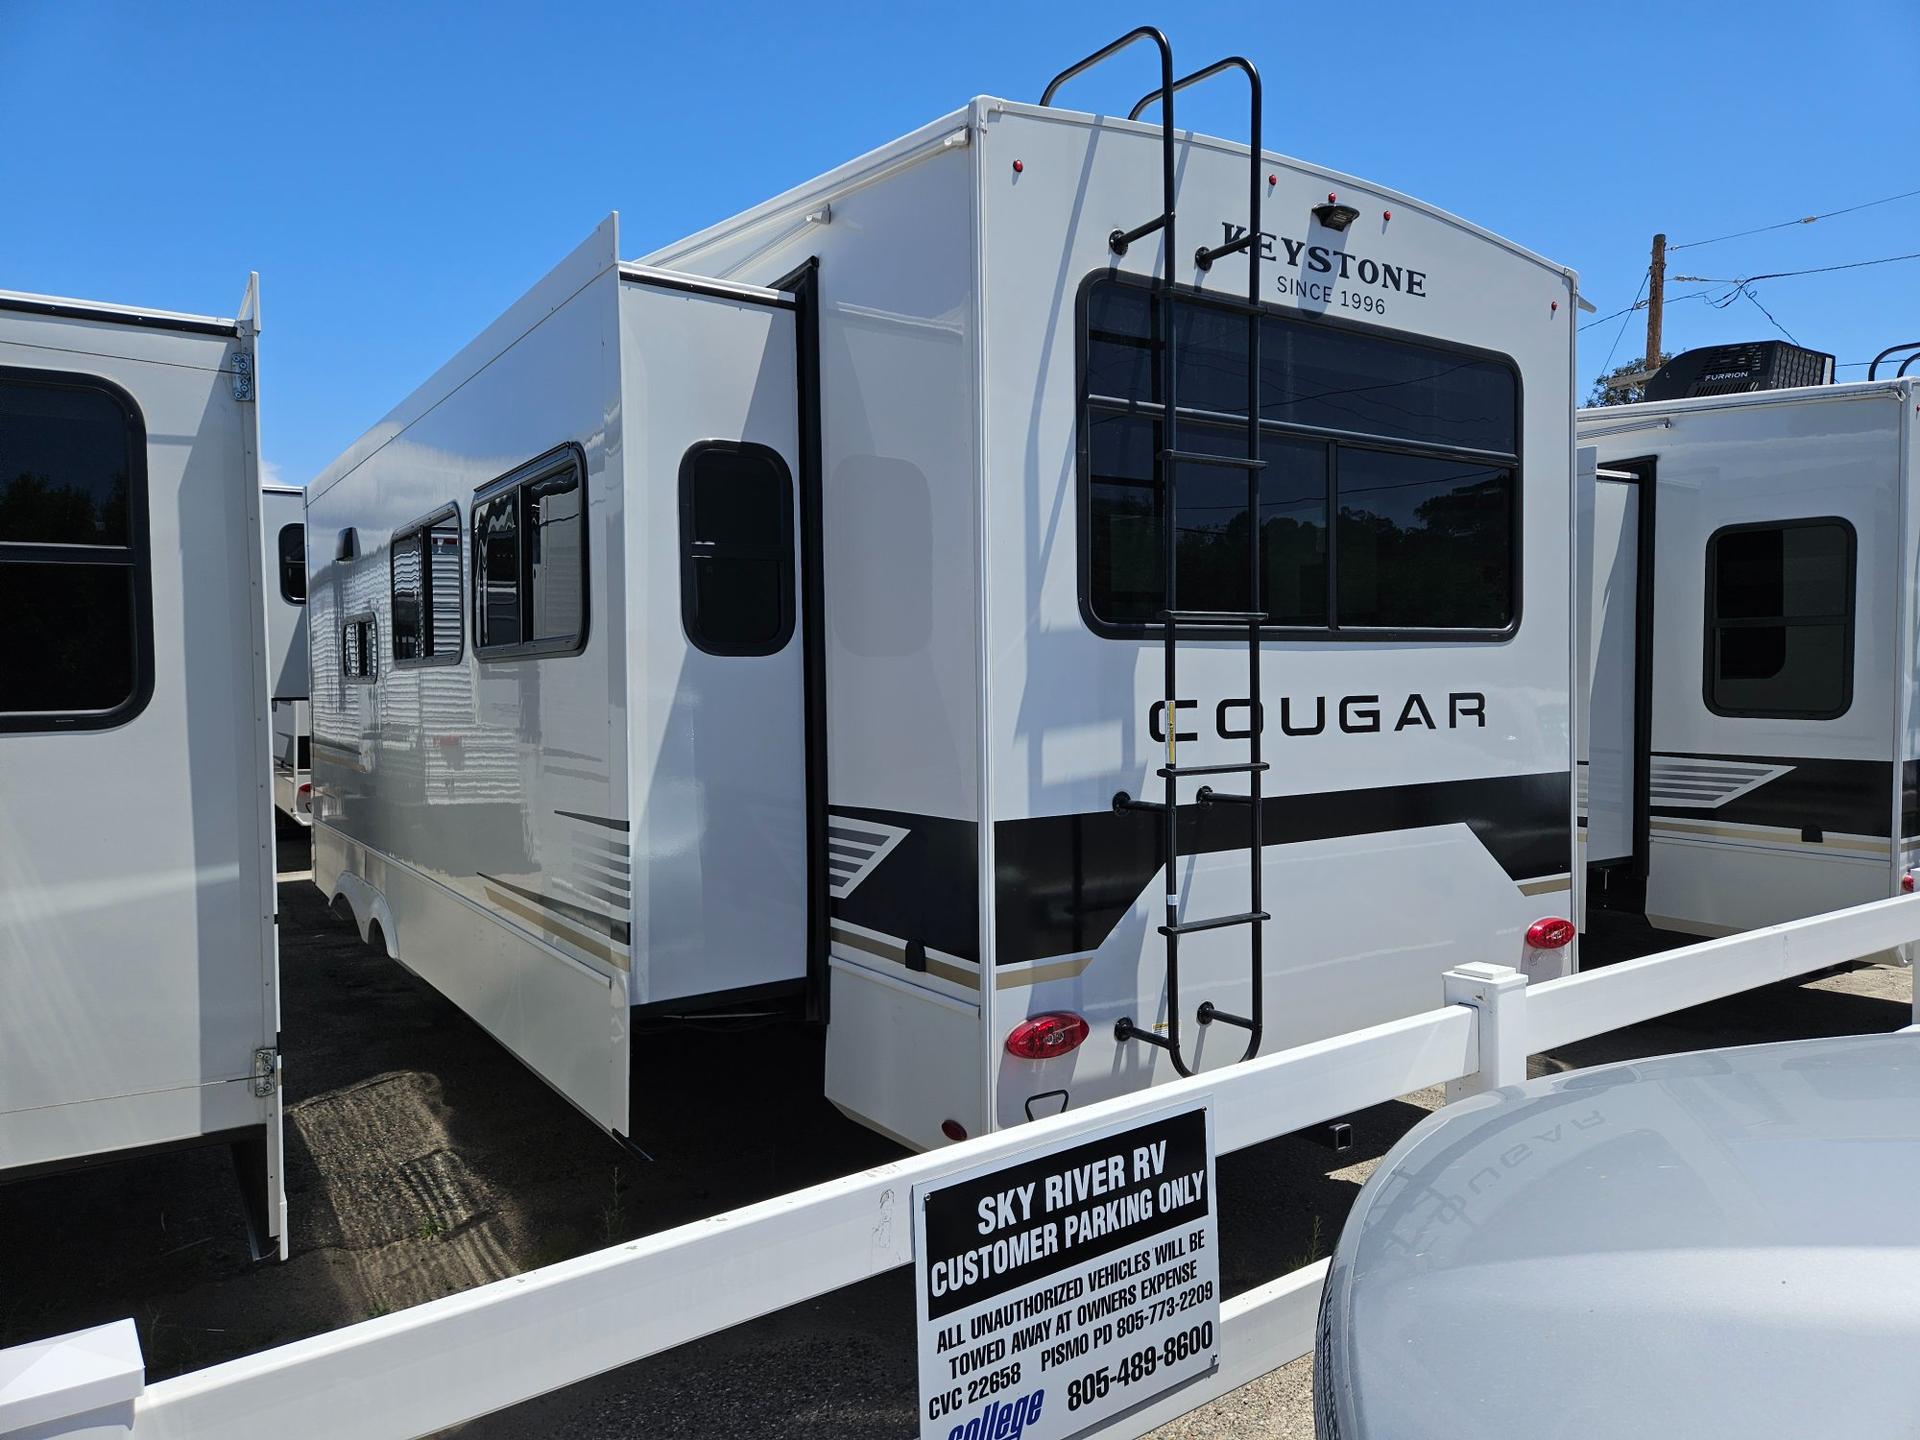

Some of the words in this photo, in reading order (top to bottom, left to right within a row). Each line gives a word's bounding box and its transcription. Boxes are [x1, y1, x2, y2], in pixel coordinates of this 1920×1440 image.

[1222, 222, 1427, 297] KEYSTONE
[1277, 275, 1332, 303] SINCE
[1341, 291, 1385, 314] 1996
[1704, 371, 1749, 381] FURRION
[1149, 692, 1486, 742] COUGAR
[931, 1223, 1058, 1297] CUSTOMER
[1065, 1189, 1152, 1248] PARKING
[1159, 1170, 1205, 1214] ONLY
[978, 1182, 1036, 1235] SKY
[1045, 1154, 1125, 1212] RIVER
[1133, 1140, 1167, 1175] RV
[937, 1327, 966, 1354] ALL
[971, 1277, 1083, 1340] UNAUTHORIZED
[1088, 1251, 1150, 1293] VEHICLES
[1154, 1238, 1186, 1266] WILL
[1189, 1229, 1205, 1250] BE
[949, 1338, 1006, 1380] TOWED
[1011, 1321, 1052, 1355] AWAY
[1055, 1310, 1073, 1337] AT
[1077, 1284, 1136, 1326] OWNERS
[1141, 1261, 1197, 1298] EXPENSE
[929, 1387, 963, 1420] CVC
[968, 1362, 1021, 1404] 22658
[1041, 1334, 1089, 1372] PISMO
[1093, 1323, 1112, 1350] PD
[1116, 1281, 1213, 1340] 805-773-2209
[1068, 1321, 1213, 1411] 805-489-8600
